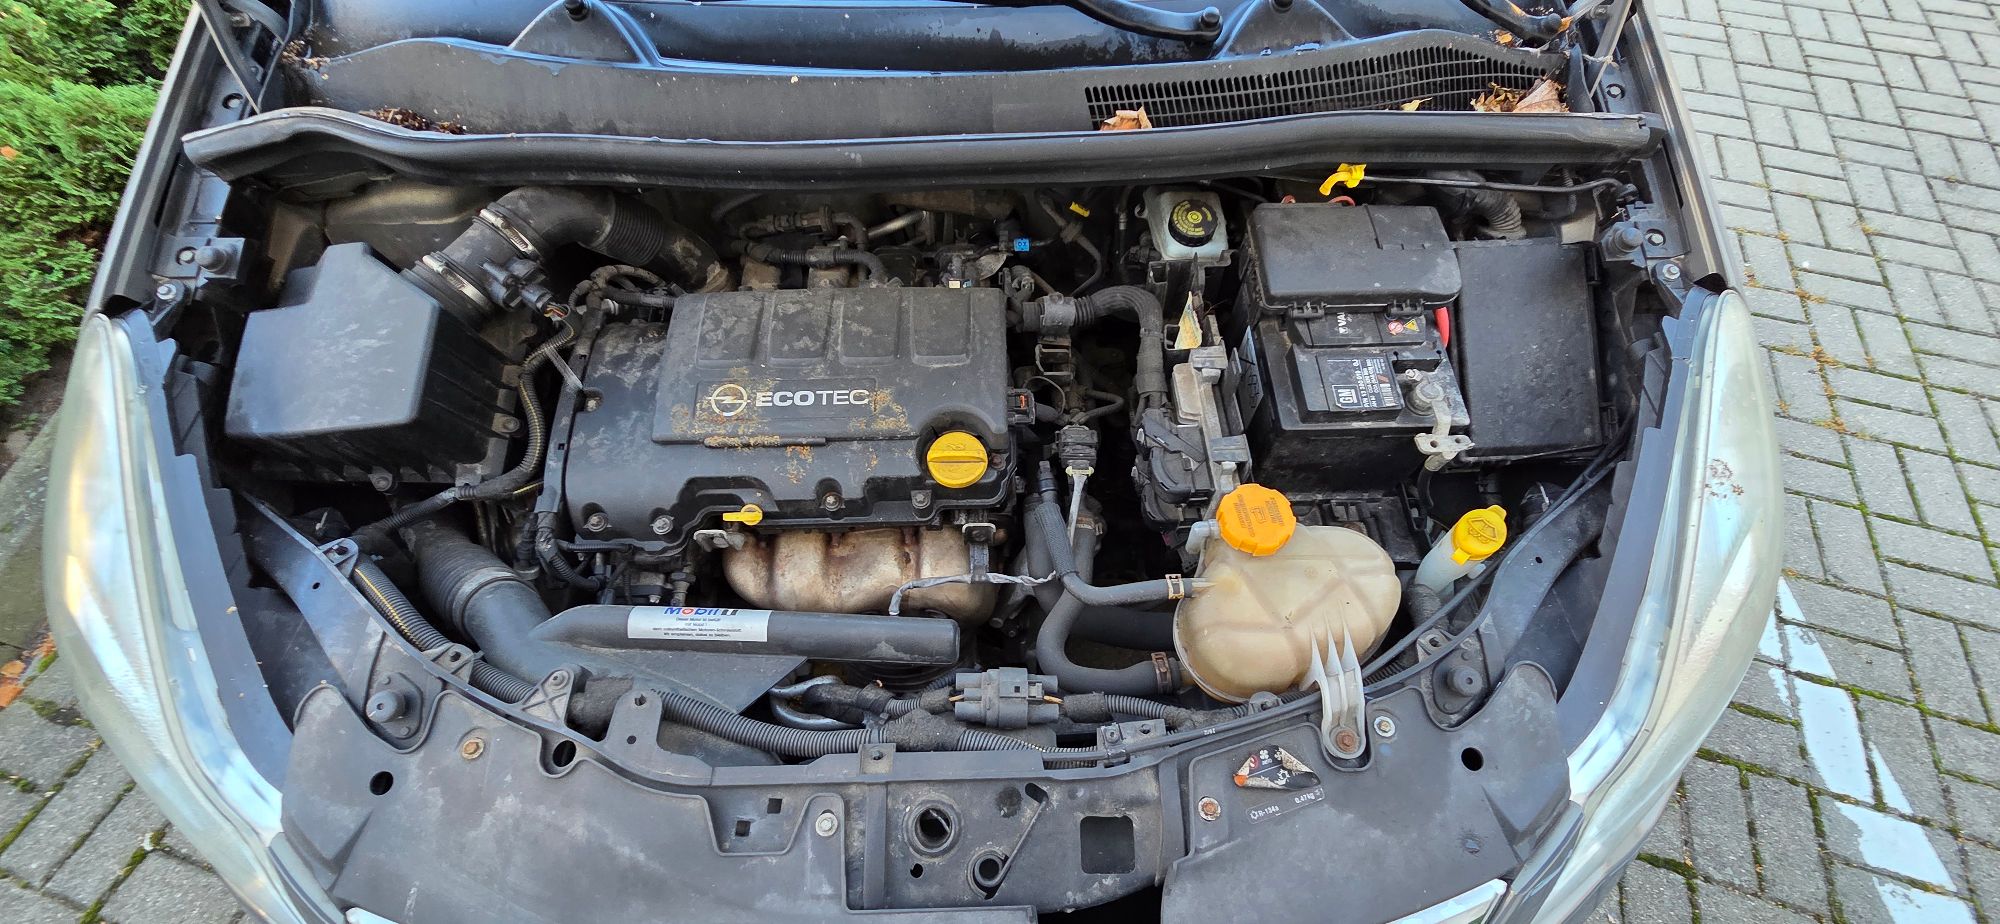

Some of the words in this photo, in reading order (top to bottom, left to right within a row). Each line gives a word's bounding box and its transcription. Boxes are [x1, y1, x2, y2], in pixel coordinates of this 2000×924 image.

[755, 389, 870, 407] ECOTEC
[1337, 388, 1354, 404] GM
[663, 607, 720, 616] Mobil
